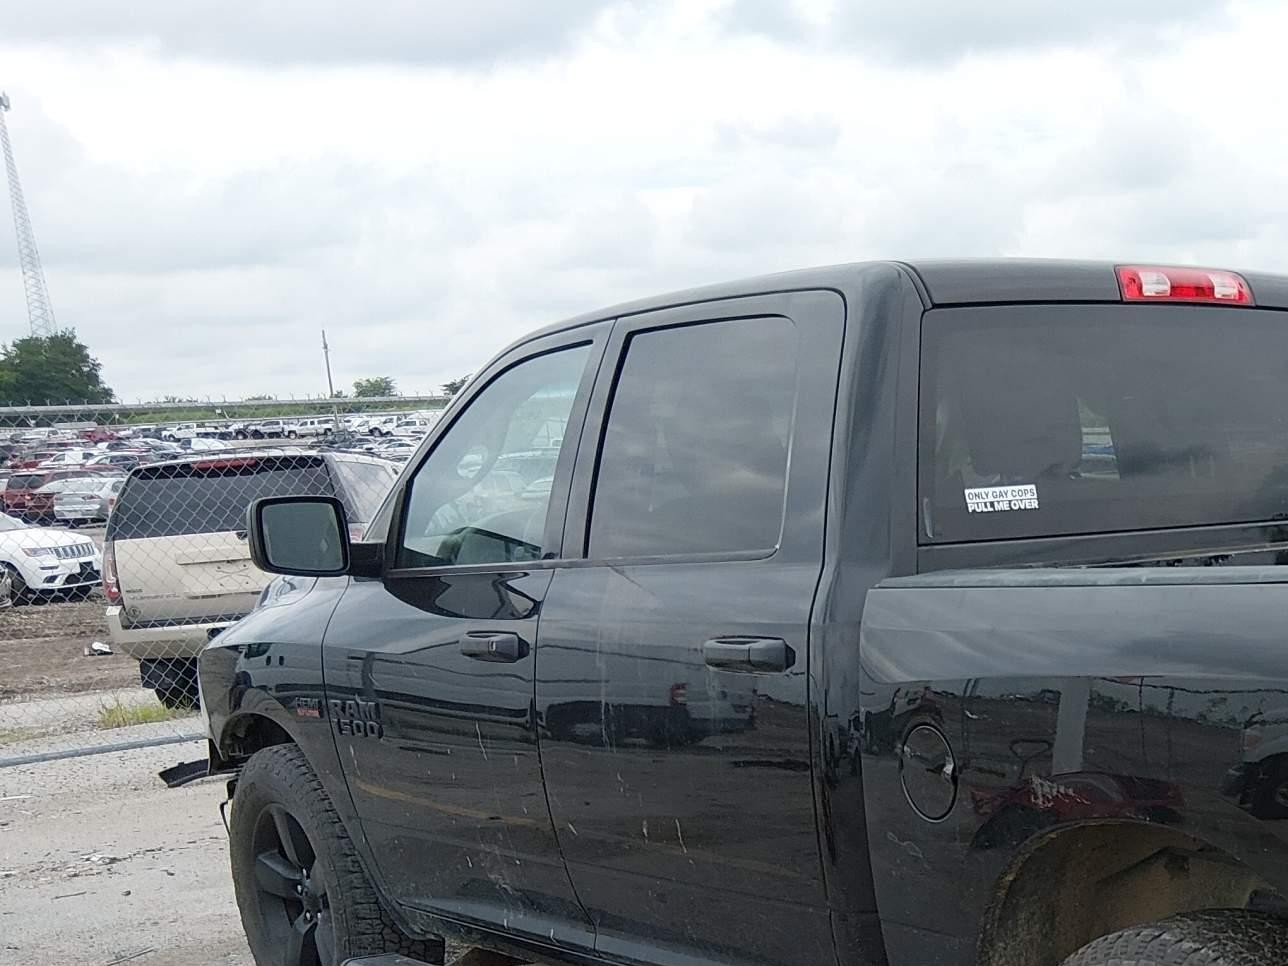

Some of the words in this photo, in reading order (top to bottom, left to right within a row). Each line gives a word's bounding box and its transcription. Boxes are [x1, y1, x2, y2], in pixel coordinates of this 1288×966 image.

[967, 491, 990, 501] ONLY
[991, 490, 1009, 500] GAY
[1010, 488, 1036, 498] COPS
[967, 502, 994, 513] PULL
[994, 501, 1010, 511] ME
[1010, 499, 1039, 510] OVER
[328, 699, 379, 720] RAM
